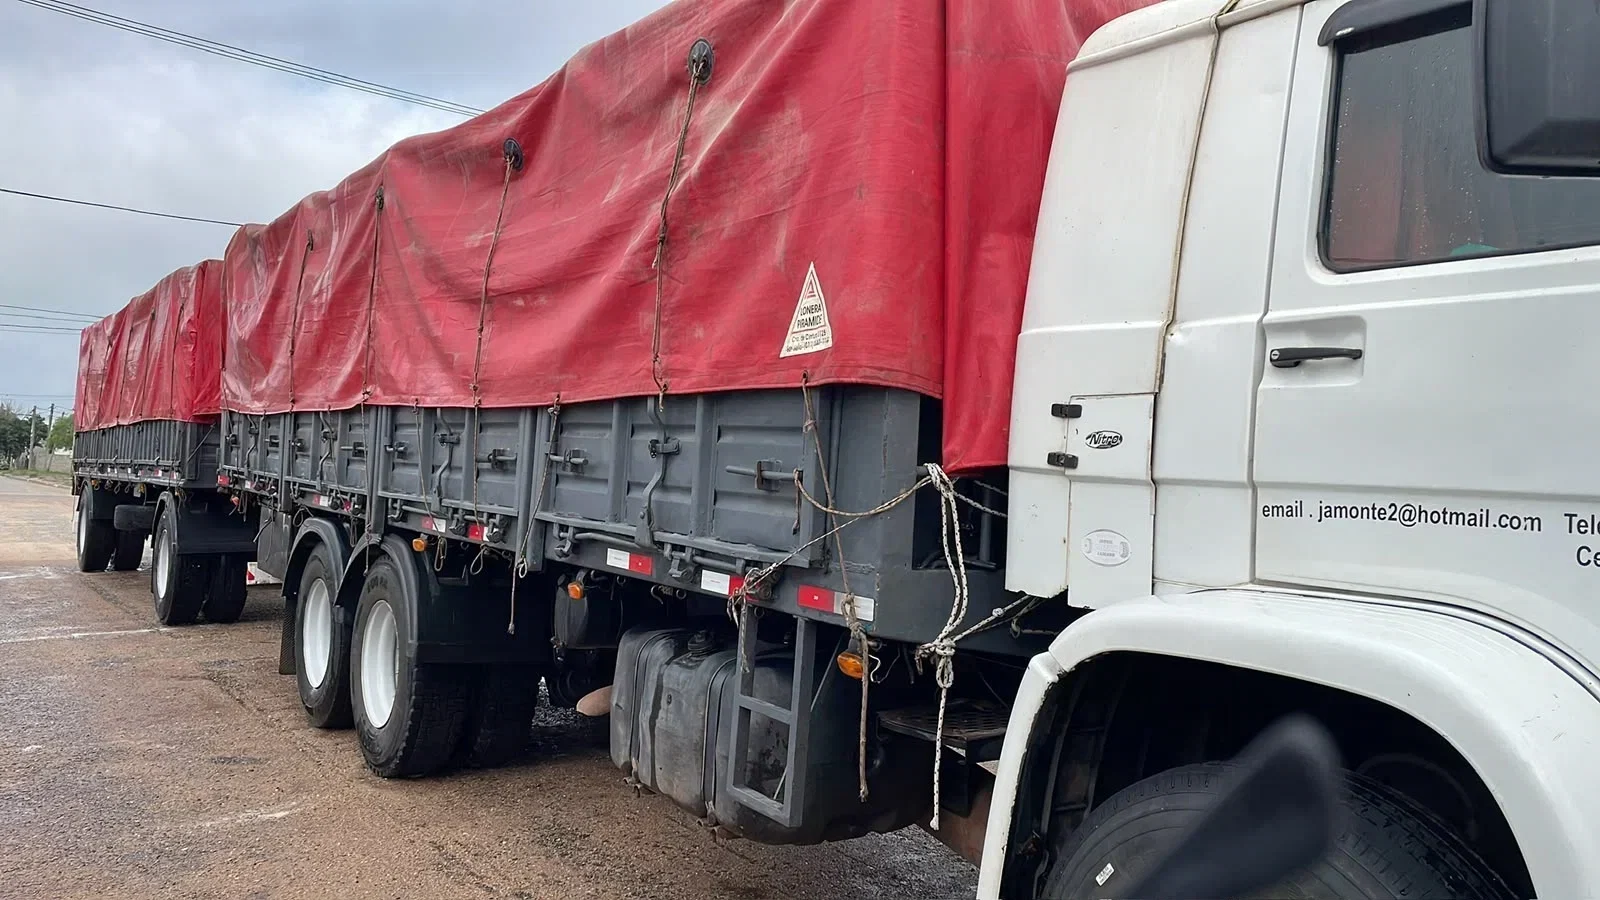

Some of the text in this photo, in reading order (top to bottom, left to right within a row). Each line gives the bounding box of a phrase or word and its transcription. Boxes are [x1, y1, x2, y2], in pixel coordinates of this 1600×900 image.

[800, 303, 821, 316] LONERA
[1089, 432, 1120, 446] Nitro
[1262, 500, 1303, 518] email
[1317, 500, 1542, 532] jamonte2@hotmail.com
[1563, 513, 1600, 536] Tel
